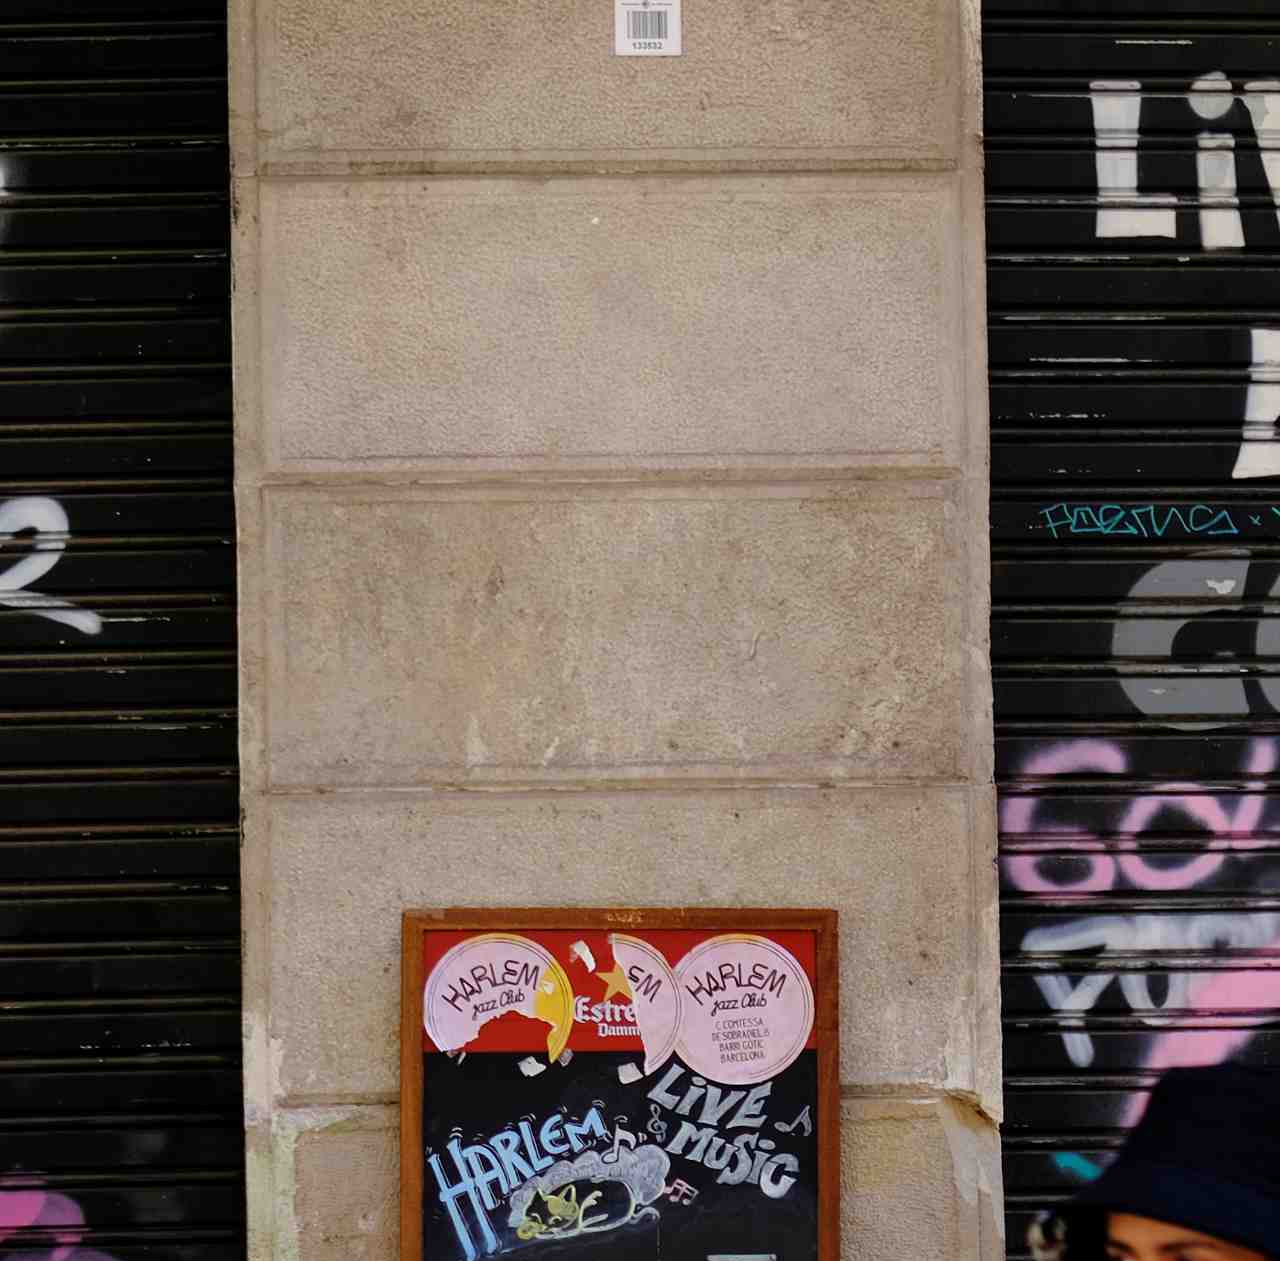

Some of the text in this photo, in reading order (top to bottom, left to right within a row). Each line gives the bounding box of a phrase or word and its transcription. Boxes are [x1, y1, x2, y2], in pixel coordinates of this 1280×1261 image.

[441, 960, 540, 1012] HARLEM
[685, 963, 787, 1006] HARLEM
[575, 994, 639, 1023] Estre
[711, 992, 768, 1017] jazz Club
[720, 1052, 765, 1064] BARCELONA
